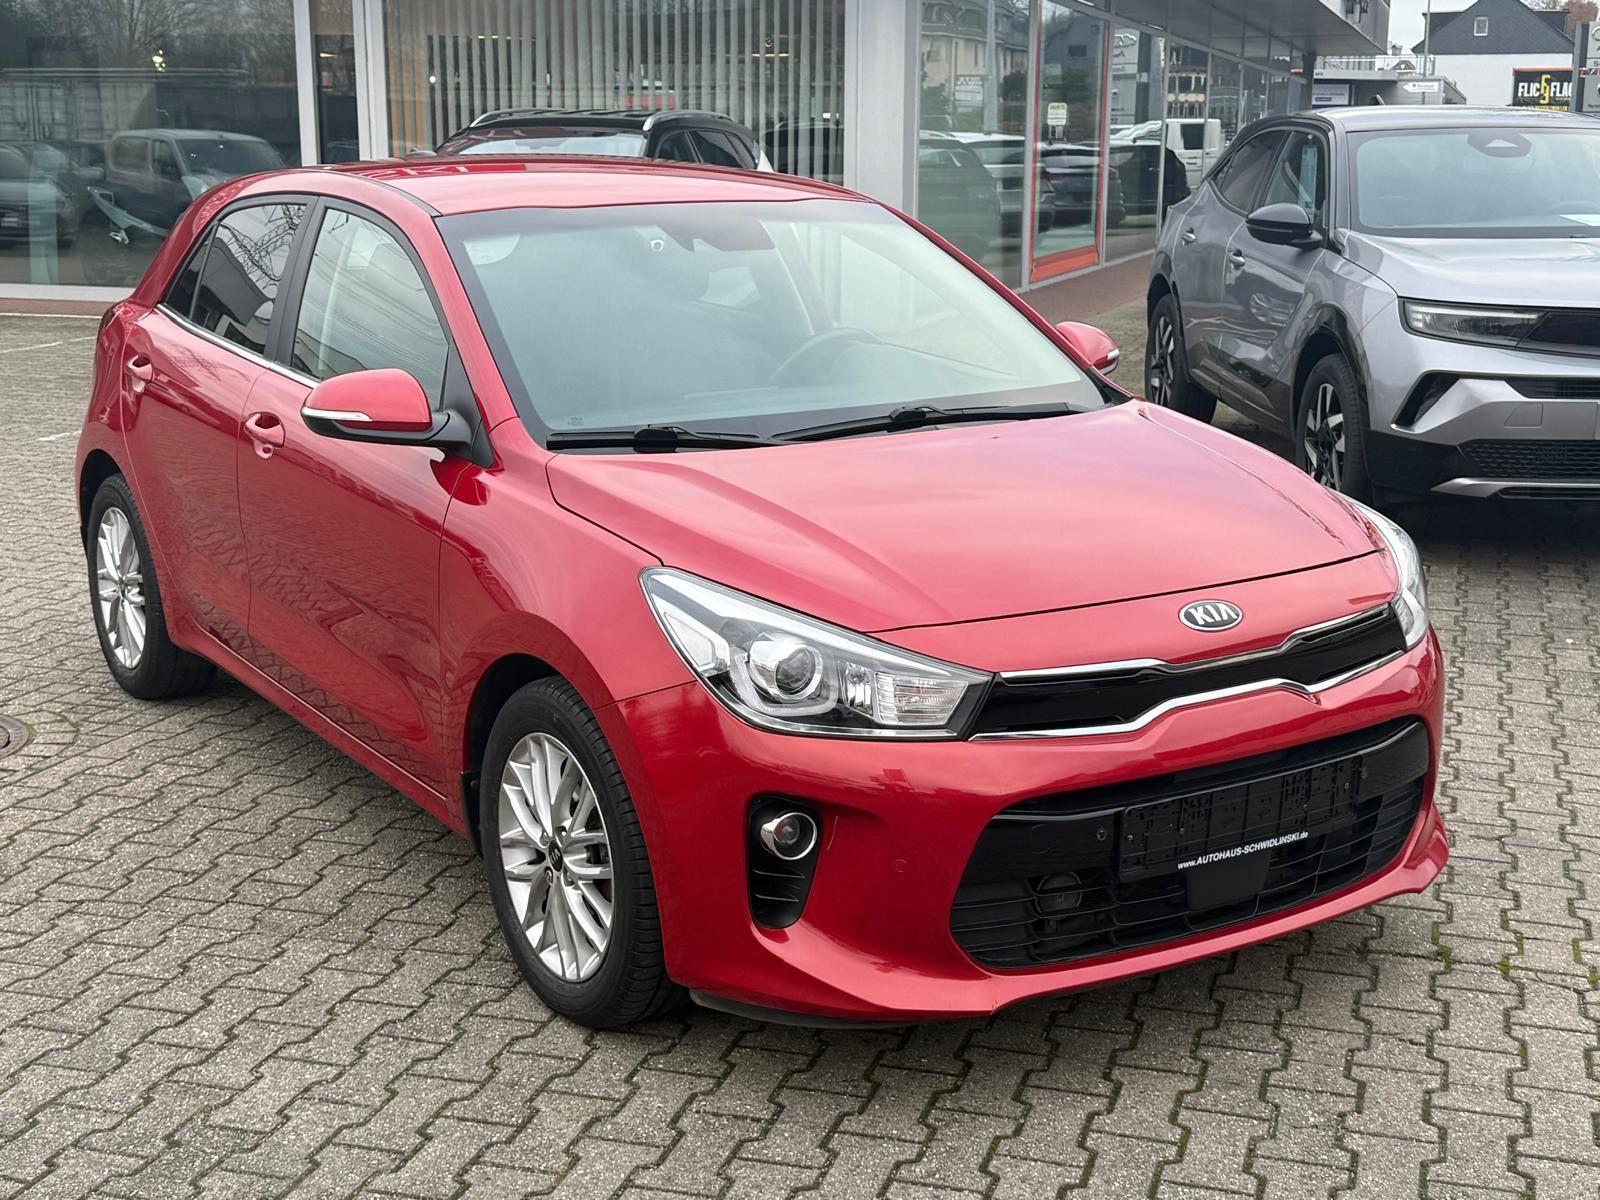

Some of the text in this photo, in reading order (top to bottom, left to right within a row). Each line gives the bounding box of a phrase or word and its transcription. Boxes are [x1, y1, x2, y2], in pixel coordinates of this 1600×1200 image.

[1518, 82, 1540, 97] FLIC
[1188, 603, 1238, 625] KIA
[1177, 831, 1309, 869] www.AUTOHAUS-SCHWIDLINSKI.de
